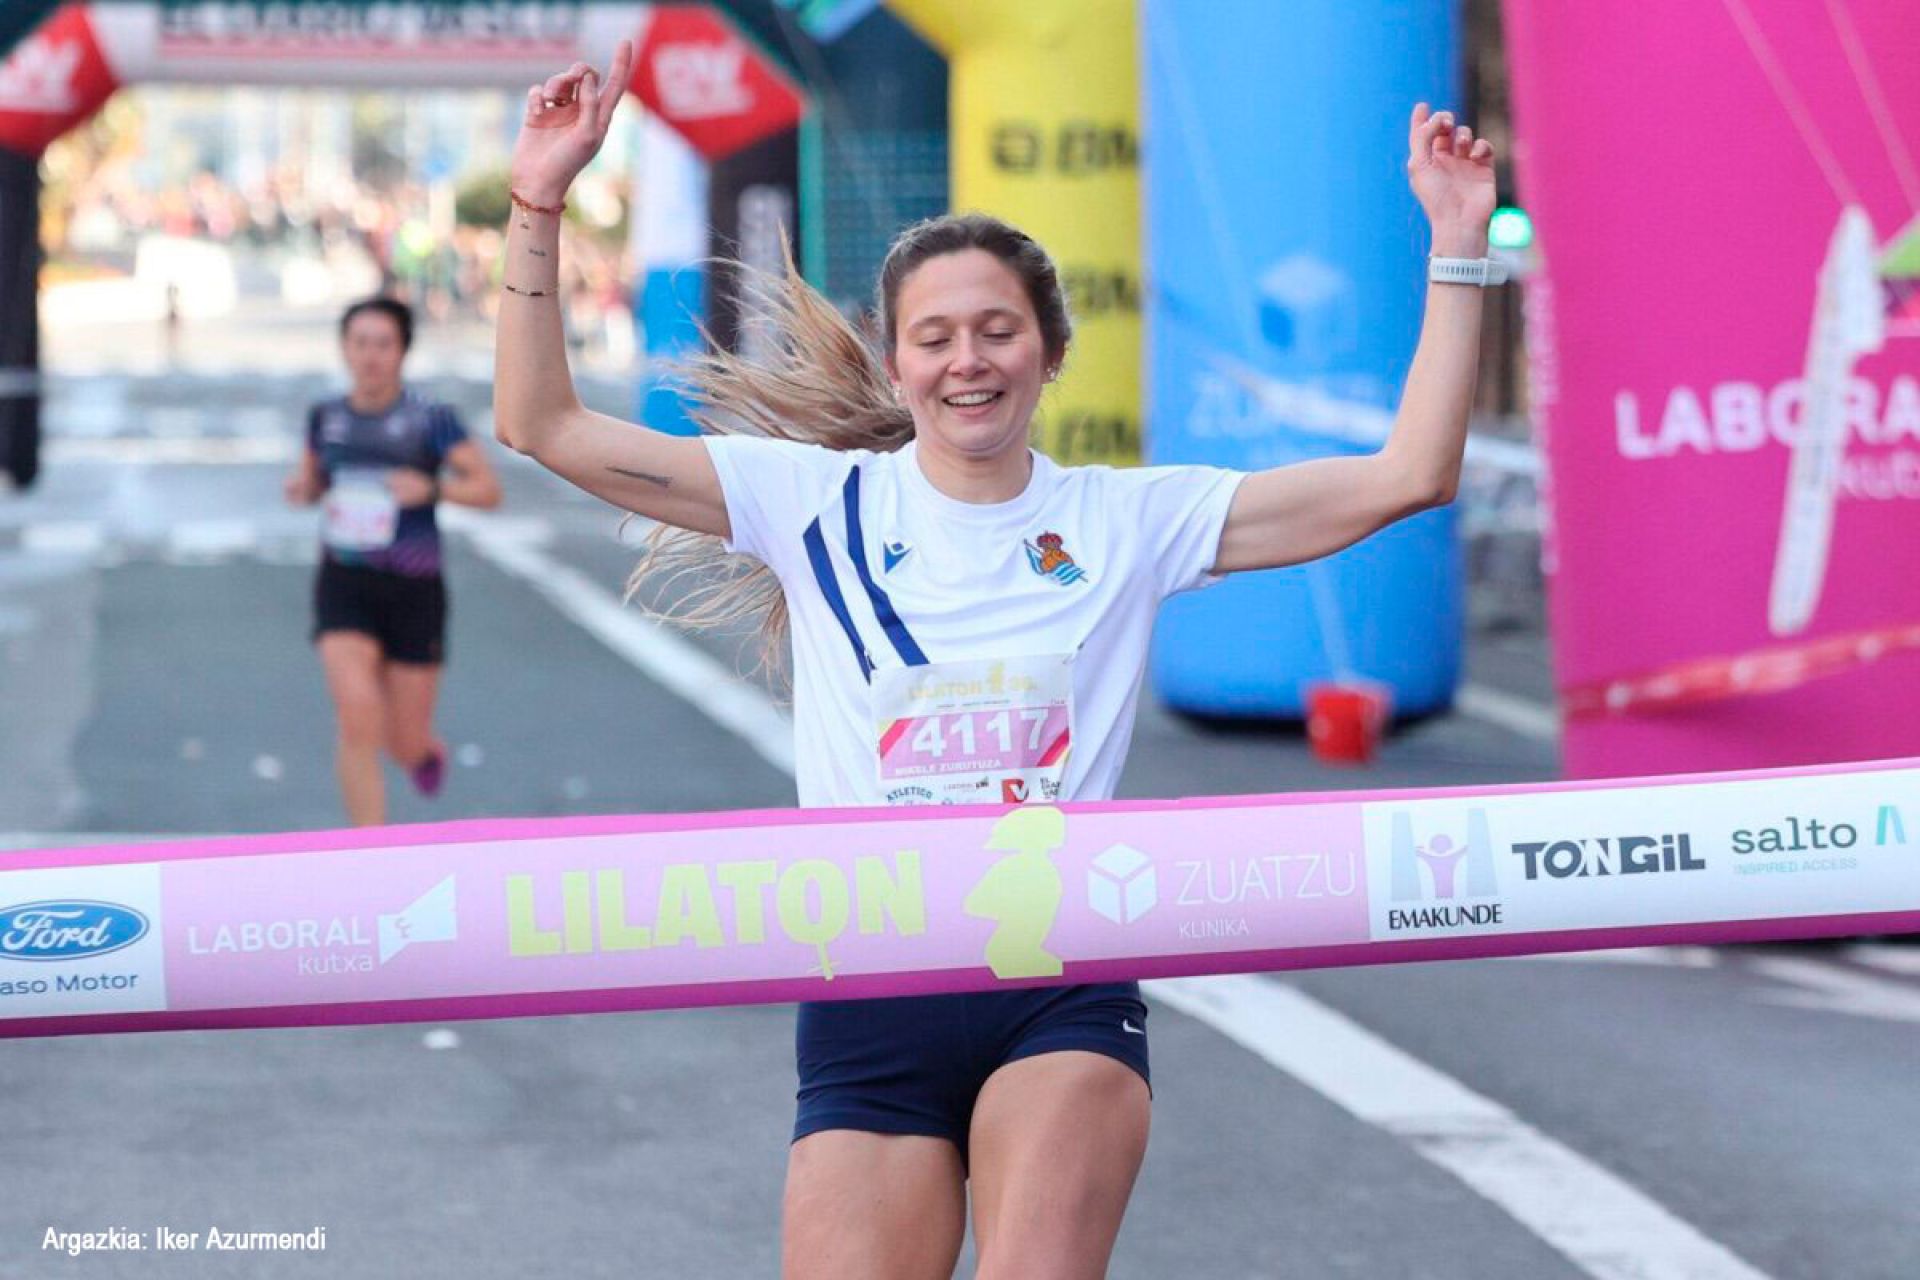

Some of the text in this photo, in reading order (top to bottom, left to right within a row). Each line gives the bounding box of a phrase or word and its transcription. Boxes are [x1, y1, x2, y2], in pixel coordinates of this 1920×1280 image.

[911, 708, 1050, 758] 4117
[1731, 816, 1858, 855] salto
[1174, 852, 1358, 906] ZUATZU
[2, 909, 114, 951] Ford
[505, 849, 927, 975] LILATON
[1179, 917, 1250, 939] KLINIKA
[1388, 903, 1504, 931] EMAKUNDE
[187, 916, 373, 955] LABORAL
[55, 973, 139, 992] Motor
[298, 951, 374, 976] kutxa
